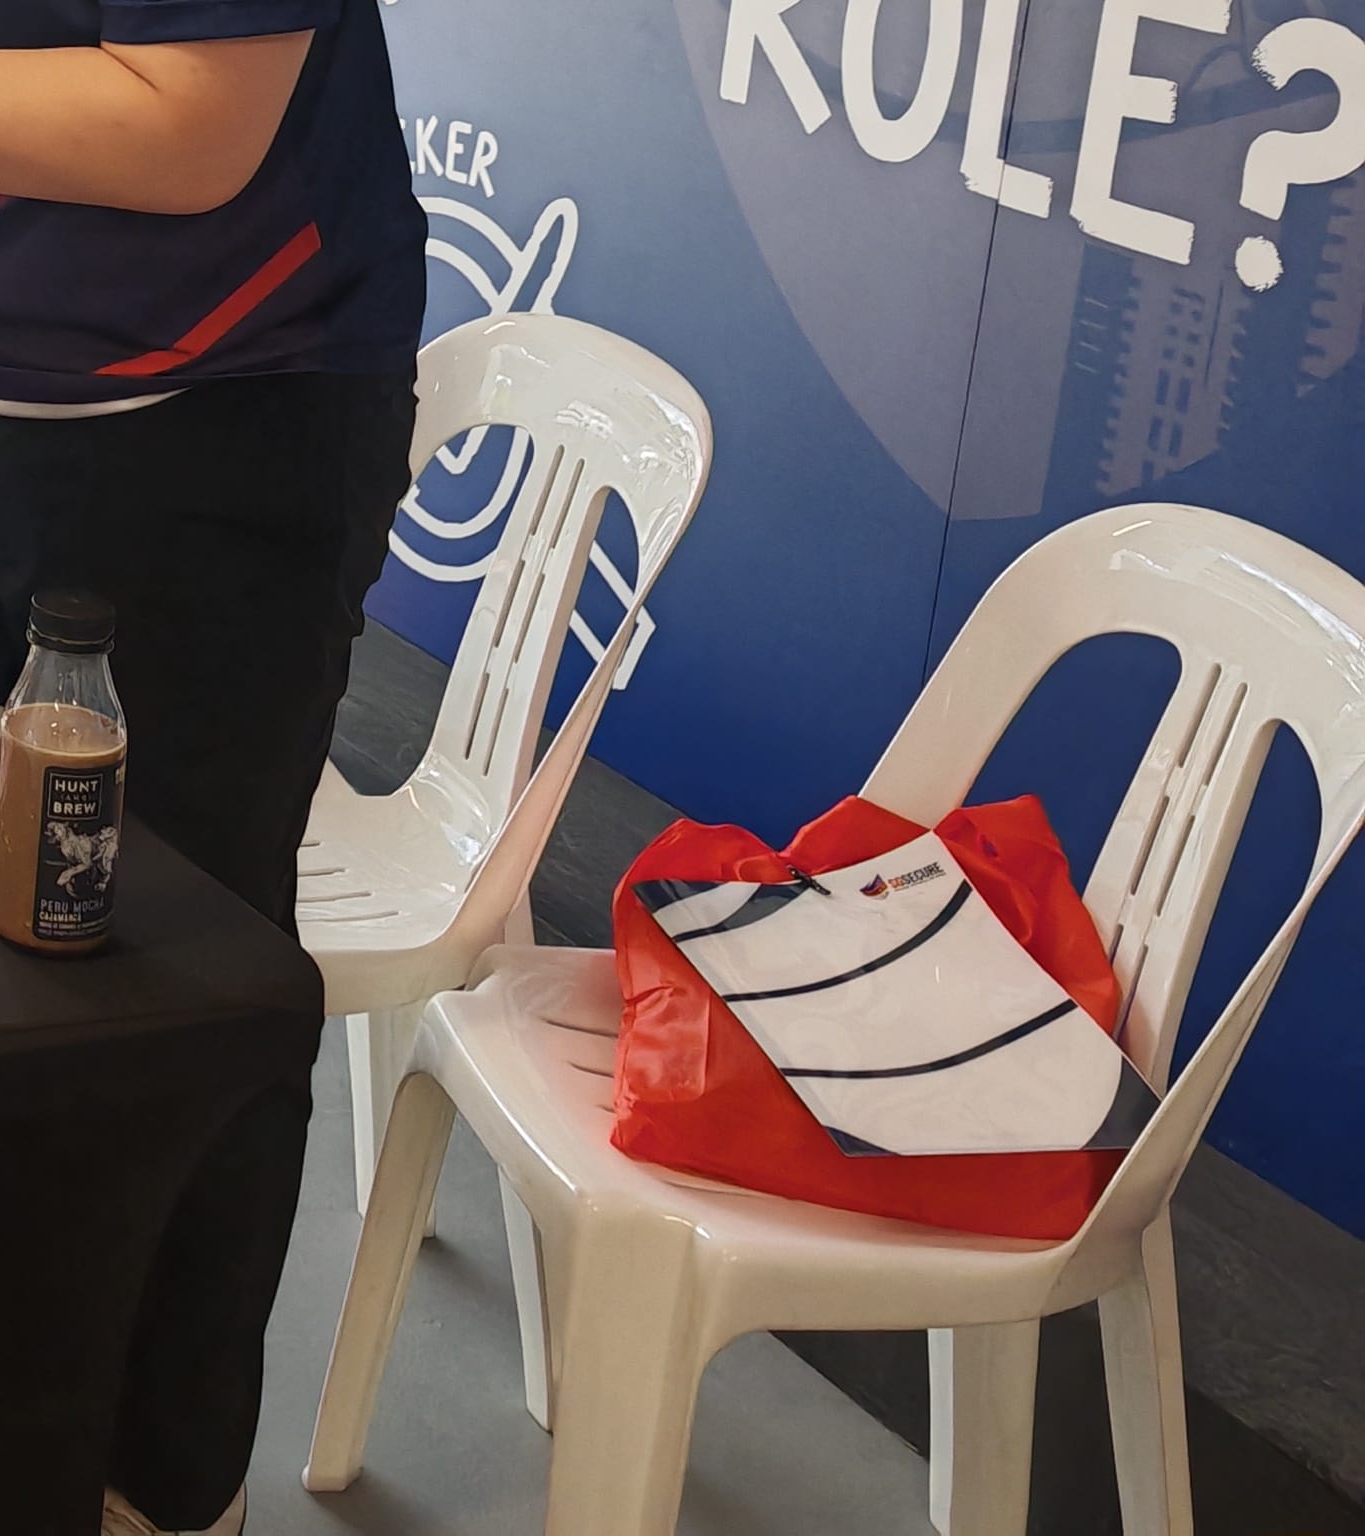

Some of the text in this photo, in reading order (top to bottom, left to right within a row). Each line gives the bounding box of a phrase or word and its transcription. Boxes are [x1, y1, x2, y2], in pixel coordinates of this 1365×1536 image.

[400, 115, 498, 197] KER
[55, 779, 99, 792] HUNT
[53, 801, 97, 815] BREW
